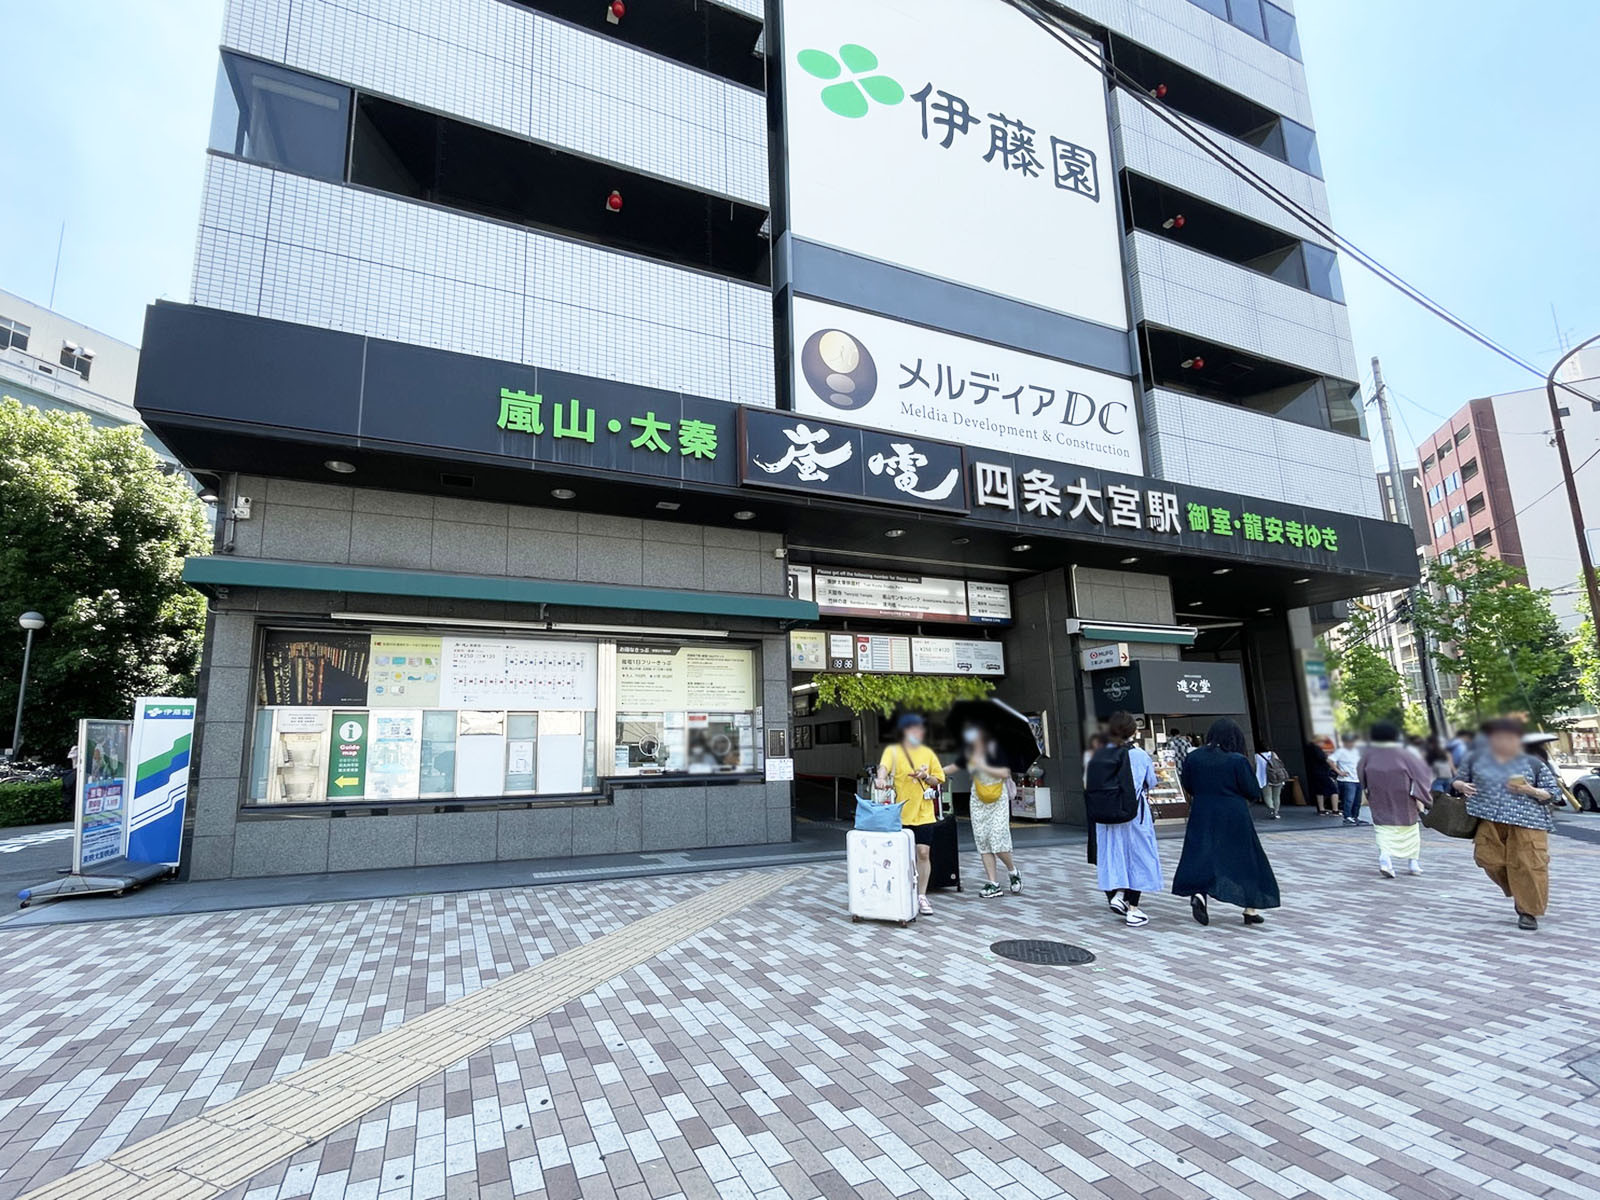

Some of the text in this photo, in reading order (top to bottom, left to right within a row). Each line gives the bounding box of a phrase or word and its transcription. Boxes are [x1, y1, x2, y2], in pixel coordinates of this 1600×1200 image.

[910, 82, 1100, 203] 伊藤園
[497, 387, 718, 460] 嵐山・太秦
[900, 401, 1131, 458] Meldia Development & Construction
[752, 423, 960, 501] 嵐電
[975, 461, 1181, 535] 四条大宮駅
[1186, 502, 1339, 553] 御室・龍安寺ゆき
[1176, 679, 1212, 693] 進々堂
